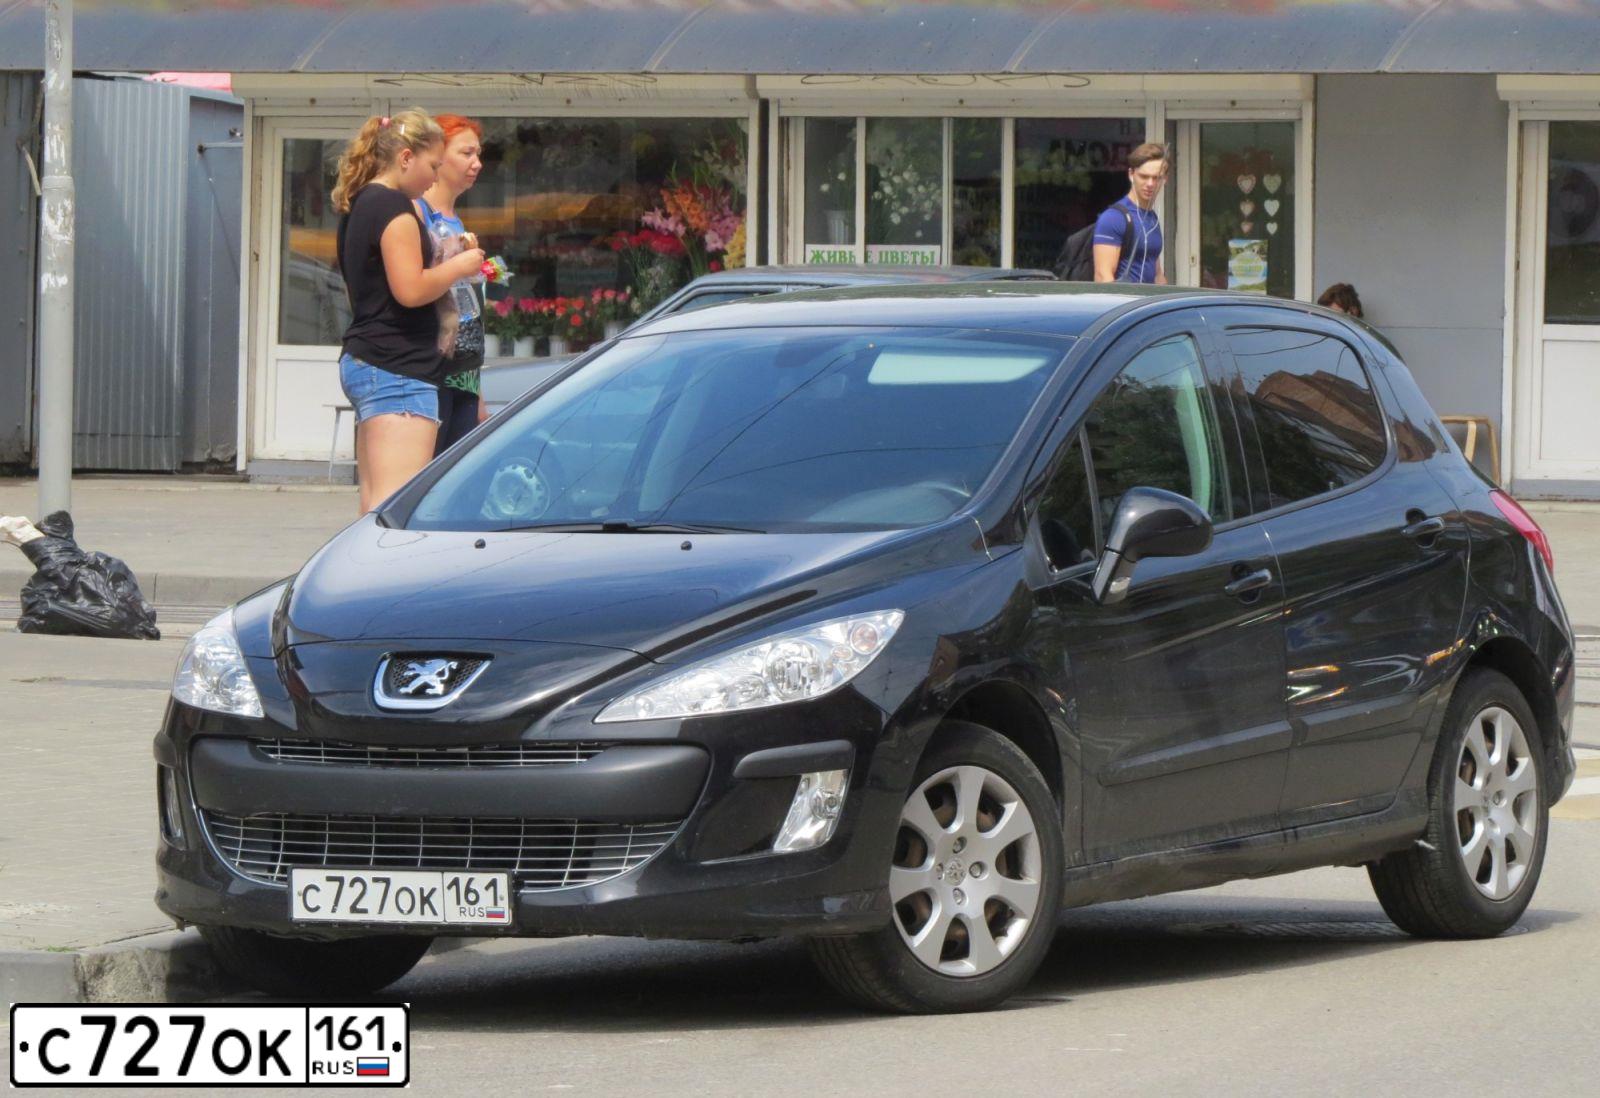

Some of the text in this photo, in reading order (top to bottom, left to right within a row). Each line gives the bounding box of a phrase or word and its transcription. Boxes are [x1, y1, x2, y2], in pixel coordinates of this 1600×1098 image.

[878, 250, 936, 264] ЦВЕТЫ
[446, 877, 498, 907] 161
[459, 906, 485, 918] RUS
